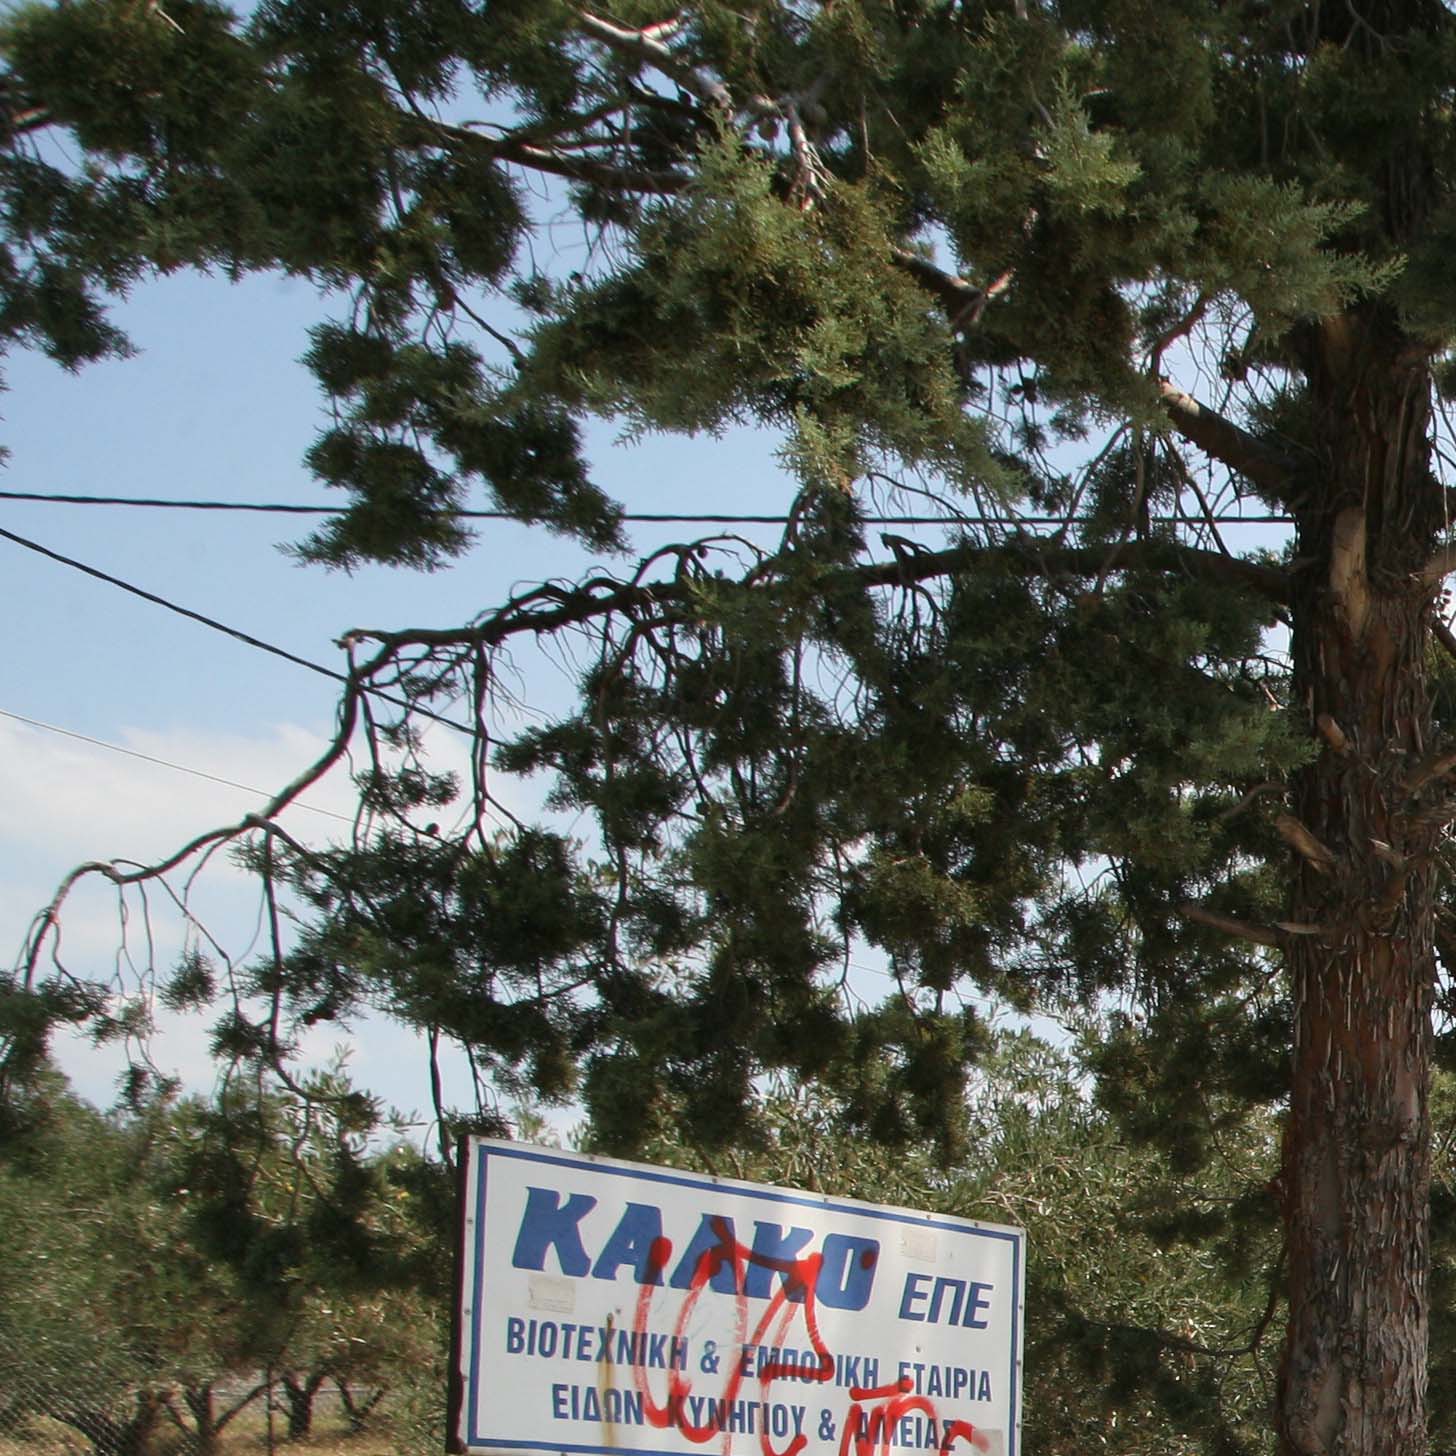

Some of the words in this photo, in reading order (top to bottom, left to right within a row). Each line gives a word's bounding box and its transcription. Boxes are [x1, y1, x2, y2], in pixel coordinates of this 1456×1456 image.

[511, 1185, 880, 1311] ΚΑΛΚΟ
[899, 1272, 994, 1329] ΕΠΕ
[506, 1316, 689, 1371] ΒΙΟΤΕΧΝΙΚΗ
[700, 1340, 721, 1374] &
[899, 1360, 993, 1403] ΕΤΑΙΡΙΑ
[552, 1383, 644, 1426] ΕΙΔΩΝ
[818, 1408, 836, 1442] &
